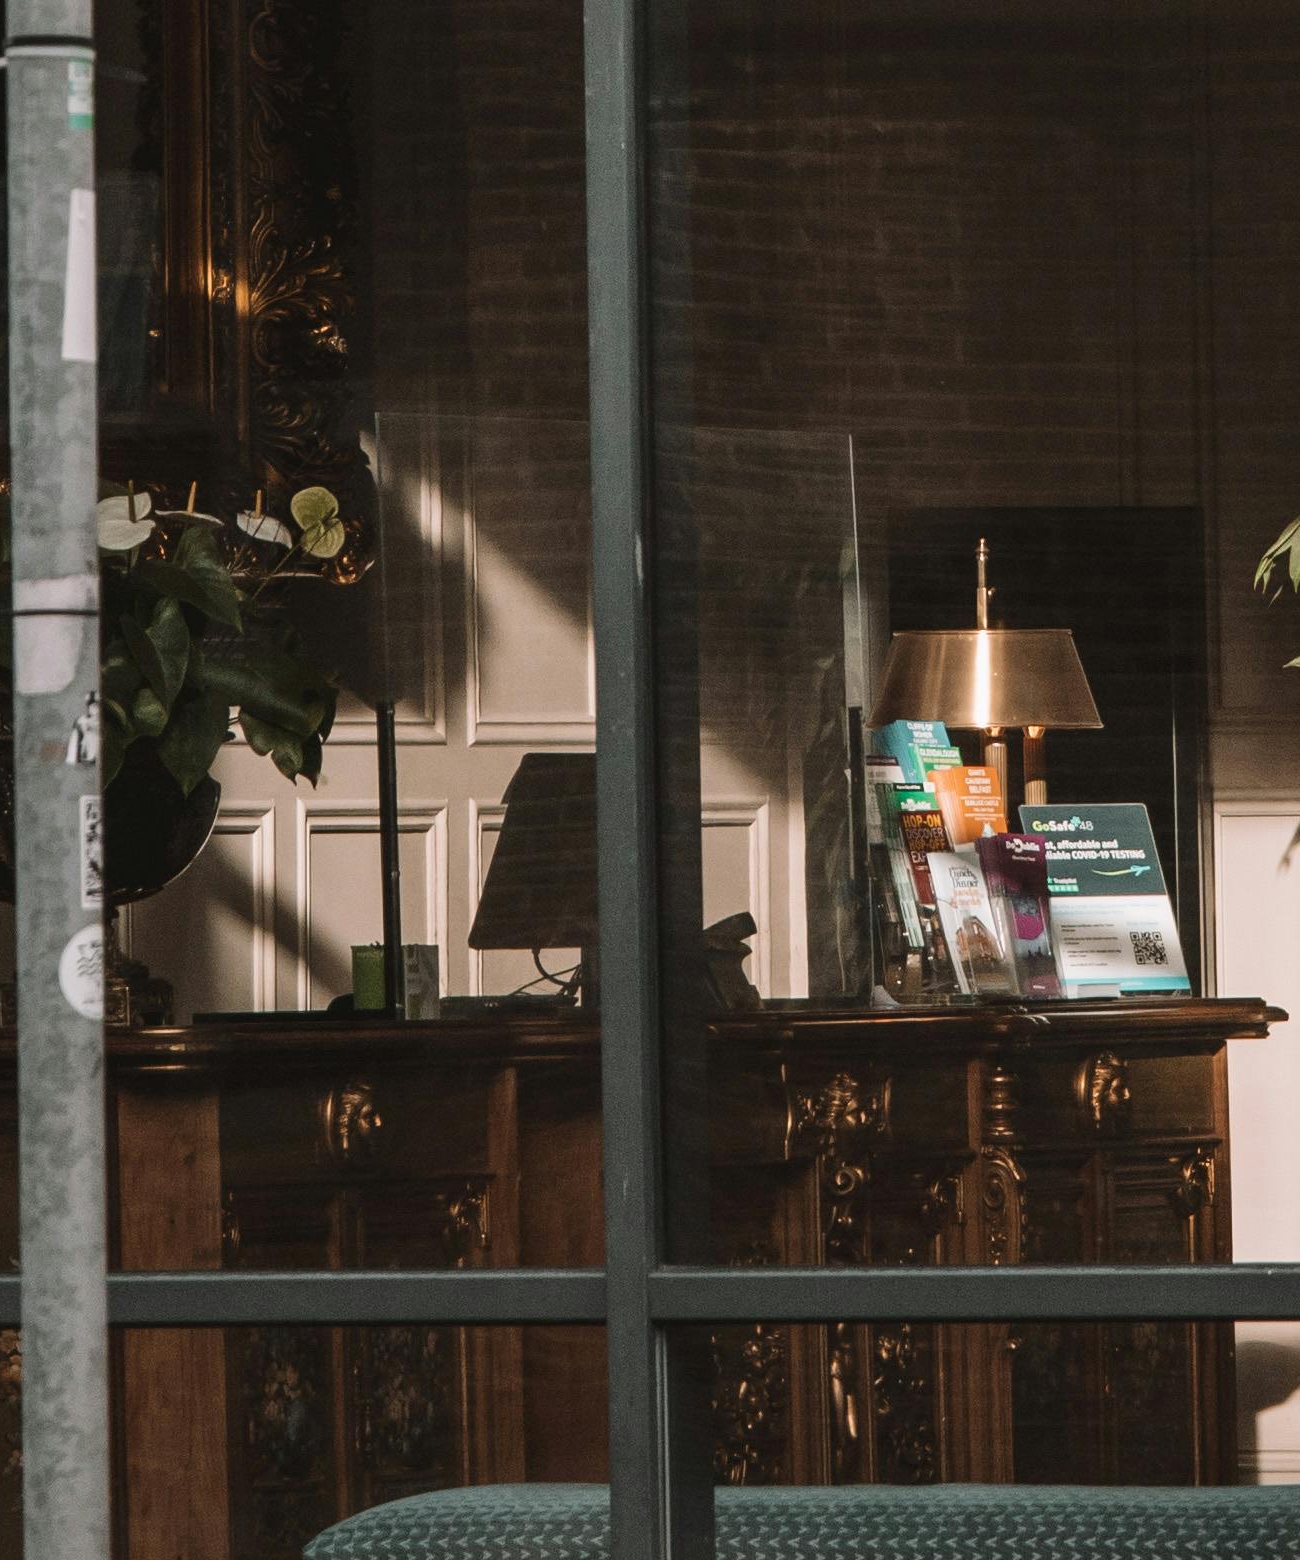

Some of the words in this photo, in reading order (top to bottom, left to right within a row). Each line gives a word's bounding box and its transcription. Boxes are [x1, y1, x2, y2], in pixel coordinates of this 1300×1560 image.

[902, 814, 942, 828] HOP-ON
[905, 827, 945, 839] DISCOVER
[908, 838, 946, 850] HOP-OFF
[1045, 841, 1056, 850] st,
[1056, 839, 1101, 849] affordable
[1101, 839, 1119, 849] and
[1045, 850, 1071, 860] liable
[1071, 850, 1110, 859] COVID-19
[1110, 849, 1146, 859] TESTING
